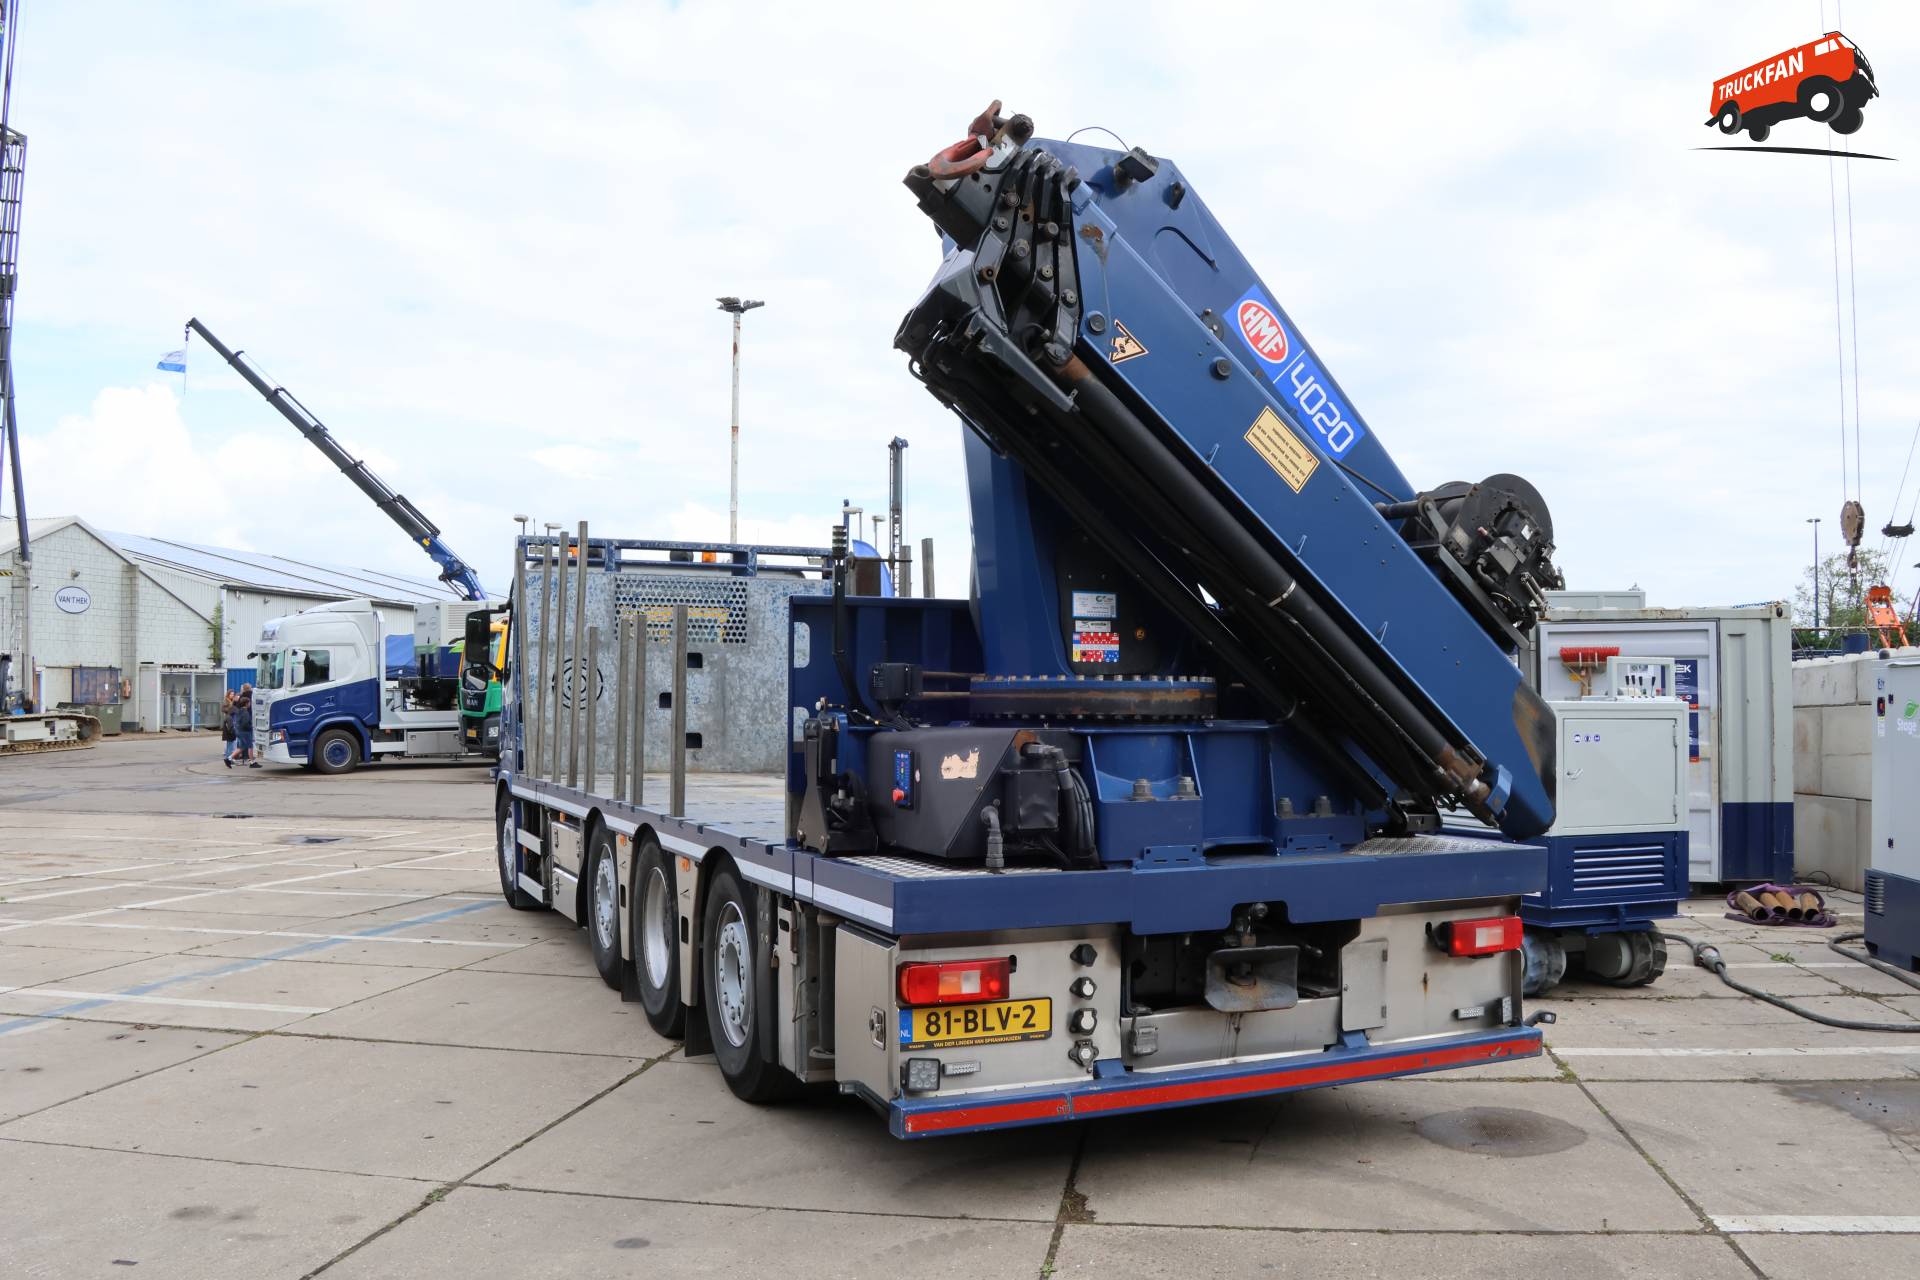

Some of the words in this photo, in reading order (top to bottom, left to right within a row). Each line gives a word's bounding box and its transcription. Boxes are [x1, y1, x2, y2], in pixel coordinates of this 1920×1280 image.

[1243, 306, 1284, 353] HMF
[1290, 361, 1355, 453] 4020
[900, 1029, 911, 1038] NL
[925, 1005, 1036, 1036] 81-BLV-2
